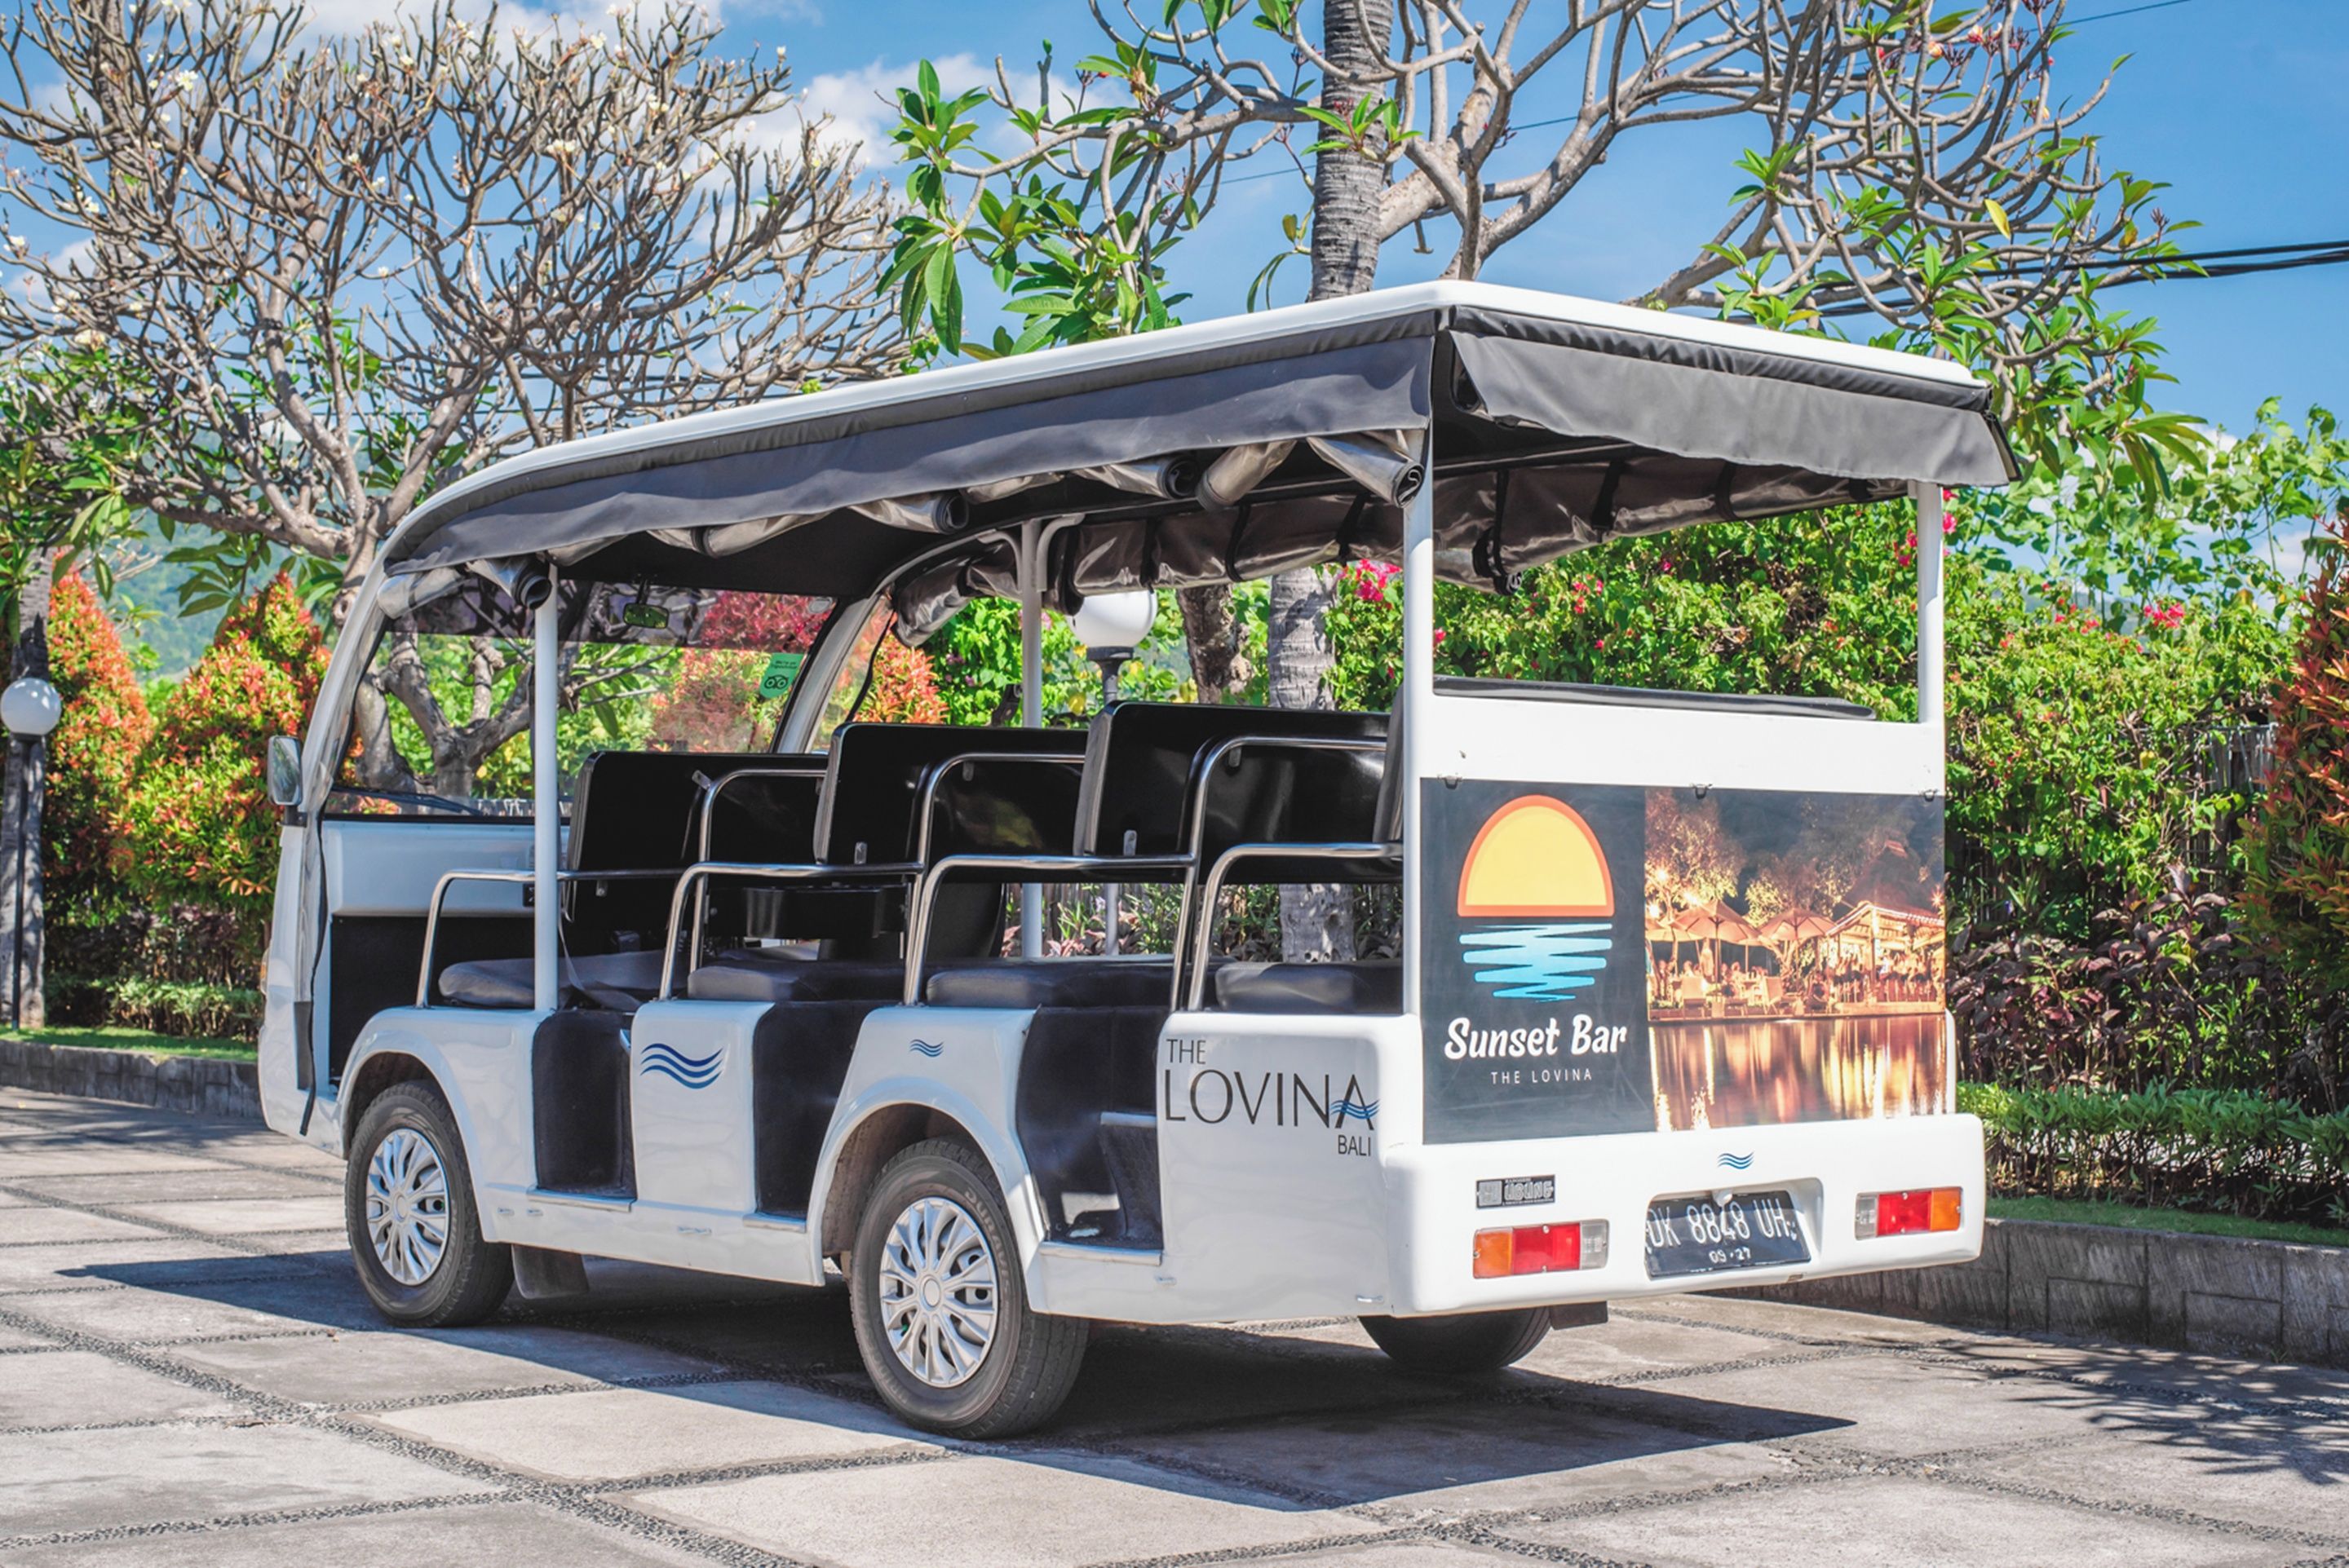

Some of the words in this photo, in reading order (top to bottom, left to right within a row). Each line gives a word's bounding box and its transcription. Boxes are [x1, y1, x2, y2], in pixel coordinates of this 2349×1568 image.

[1166, 1039, 1206, 1065] THE
[1444, 1017, 1560, 1060] Sunset
[1571, 1014, 1627, 1055] Bar
[1491, 1071, 1520, 1084] THE
[1532, 1068, 1592, 1084] LOVINA
[1165, 1069, 1375, 1131] LOVINA
[1338, 1134, 1371, 1156] BALI
[1646, 1206, 1681, 1248] DK
[1686, 1200, 1750, 1243] 8848
[1753, 1198, 1789, 1239] UH
